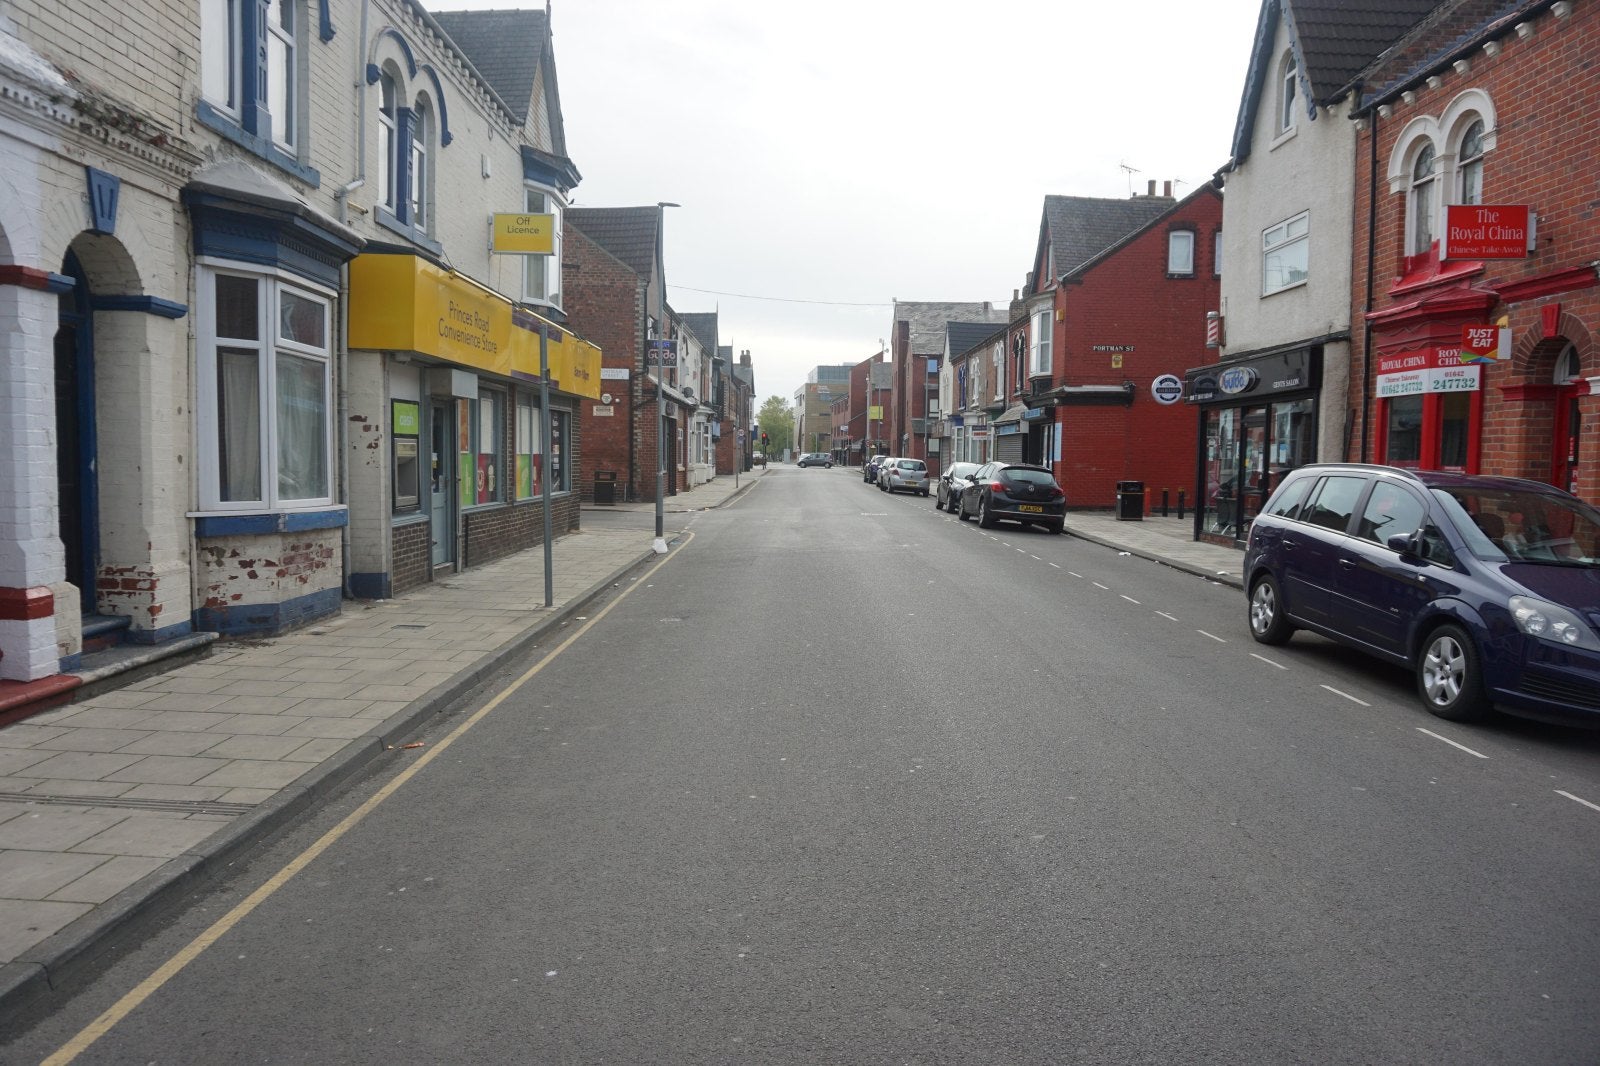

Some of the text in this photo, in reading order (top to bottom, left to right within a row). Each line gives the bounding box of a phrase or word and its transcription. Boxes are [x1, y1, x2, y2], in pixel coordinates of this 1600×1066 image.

[516, 217, 530, 225] Off
[1476, 209, 1499, 223] The
[507, 226, 540, 234] Licence
[1451, 225, 1523, 243] Royal China
[448, 300, 490, 333] Princes Road
[438, 317, 497, 353] Convenience Store
[1467, 329, 1494, 339] JUST
[1472, 339, 1494, 347] EAT
[647, 348, 676, 359] Gudo
[1381, 356, 1426, 371] ROYAL CHINA
[1381, 381, 1423, 395] 01642 247732
[1433, 378, 1475, 390] 247732
